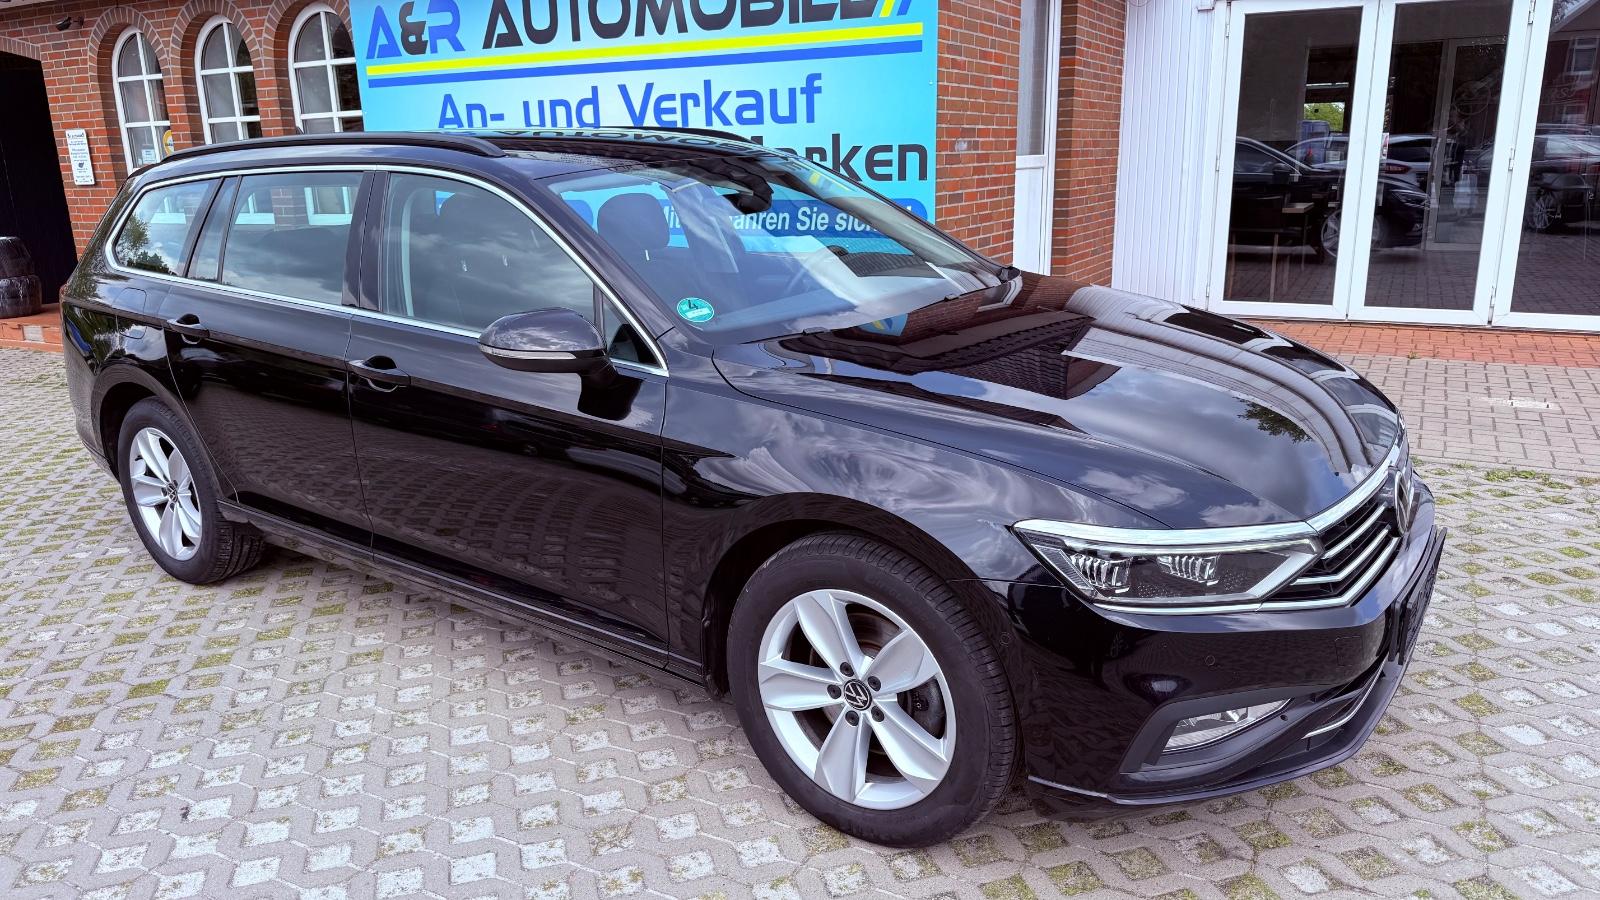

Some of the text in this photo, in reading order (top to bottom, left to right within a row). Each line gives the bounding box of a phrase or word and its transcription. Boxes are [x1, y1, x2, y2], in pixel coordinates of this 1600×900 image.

[366, 0, 879, 59] A&R AUTOMO
[438, 72, 822, 129] An- und Verkauf
[750, 133, 928, 182] rken
[729, 211, 790, 231] ahren
[796, 206, 829, 231] Sie
